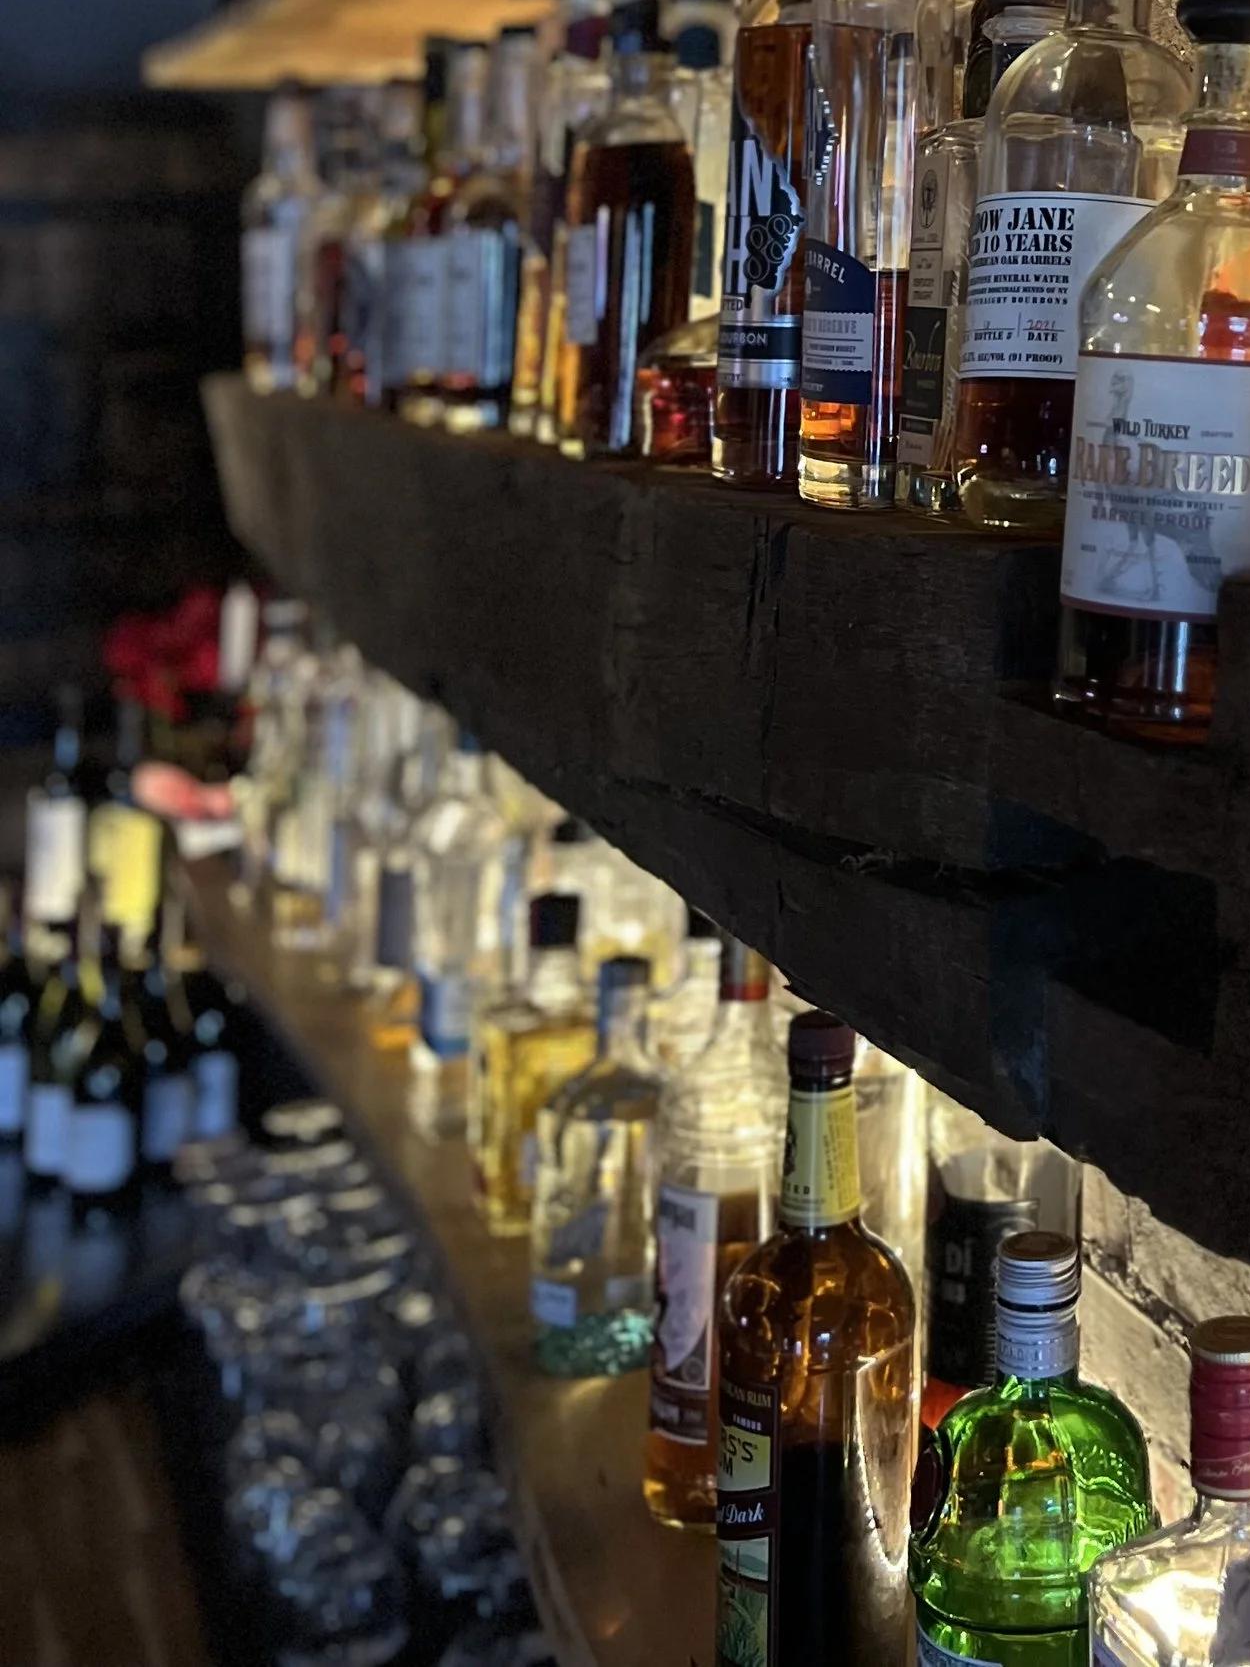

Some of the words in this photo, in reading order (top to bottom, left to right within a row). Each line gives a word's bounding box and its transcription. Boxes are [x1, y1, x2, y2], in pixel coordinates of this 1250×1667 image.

[1008, 207, 1075, 231] JANE
[984, 235, 999, 254] 10
[1005, 234, 1073, 253] YEARS
[1001, 255, 1019, 265] OAK
[1021, 255, 1072, 266] BARRELS
[993, 274, 1031, 284] MINERAL
[1034, 274, 1070, 284] WATER
[1012, 296, 1068, 305] BOURBONS
[974, 331, 1003, 341] BOTTLE
[1027, 332, 1058, 342] DATE
[1025, 353, 1063, 365] PROOF)
[1112, 418, 1140, 437] WILD
[1143, 418, 1191, 440] TURKEY
[1073, 436, 1132, 487] RARE
[1187, 500, 1225, 512] WHISKEY
[1091, 505, 1149, 525] BARREL
[1153, 513, 1215, 531] PROOF
[747, 1391, 772, 1409] RUM
[726, 1502, 764, 1524] Dark
